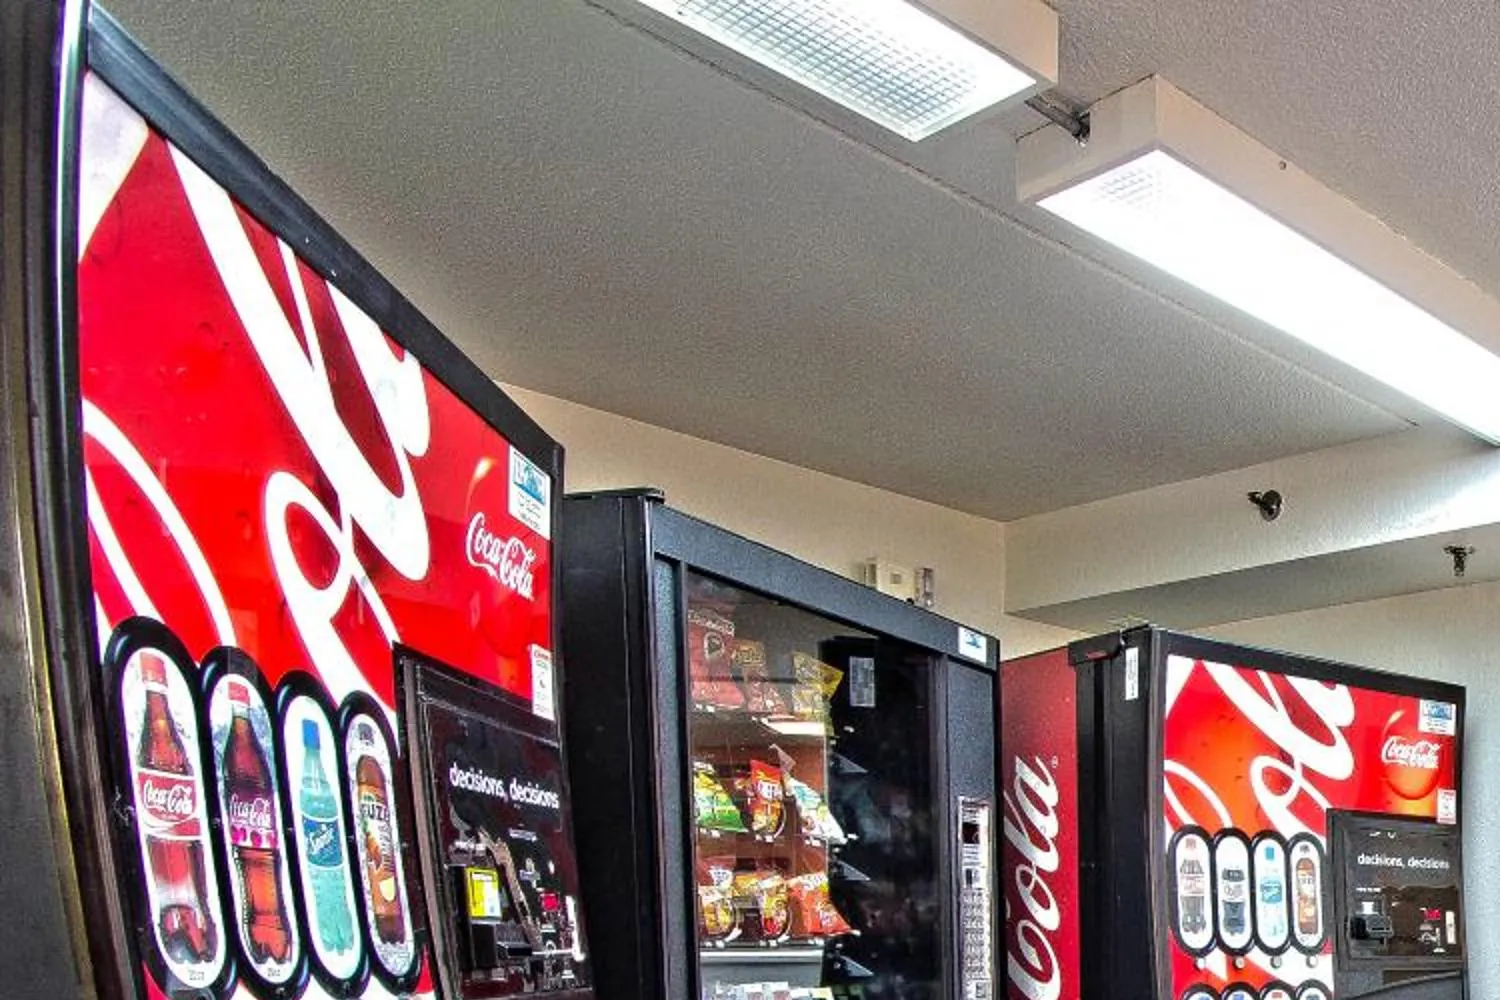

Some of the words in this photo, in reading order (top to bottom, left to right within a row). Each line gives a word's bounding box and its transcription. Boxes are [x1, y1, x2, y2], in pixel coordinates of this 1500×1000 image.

[466, 511, 536, 602] Coca-Cola
[1381, 735, 1442, 769] Coca-Cola
[144, 779, 193, 815] Coca-Cola
[449, 762, 508, 803] decisions,
[509, 777, 560, 810] decisions
[1357, 852, 1406, 869] decisions,
[1407, 856, 1450, 870] decisions
